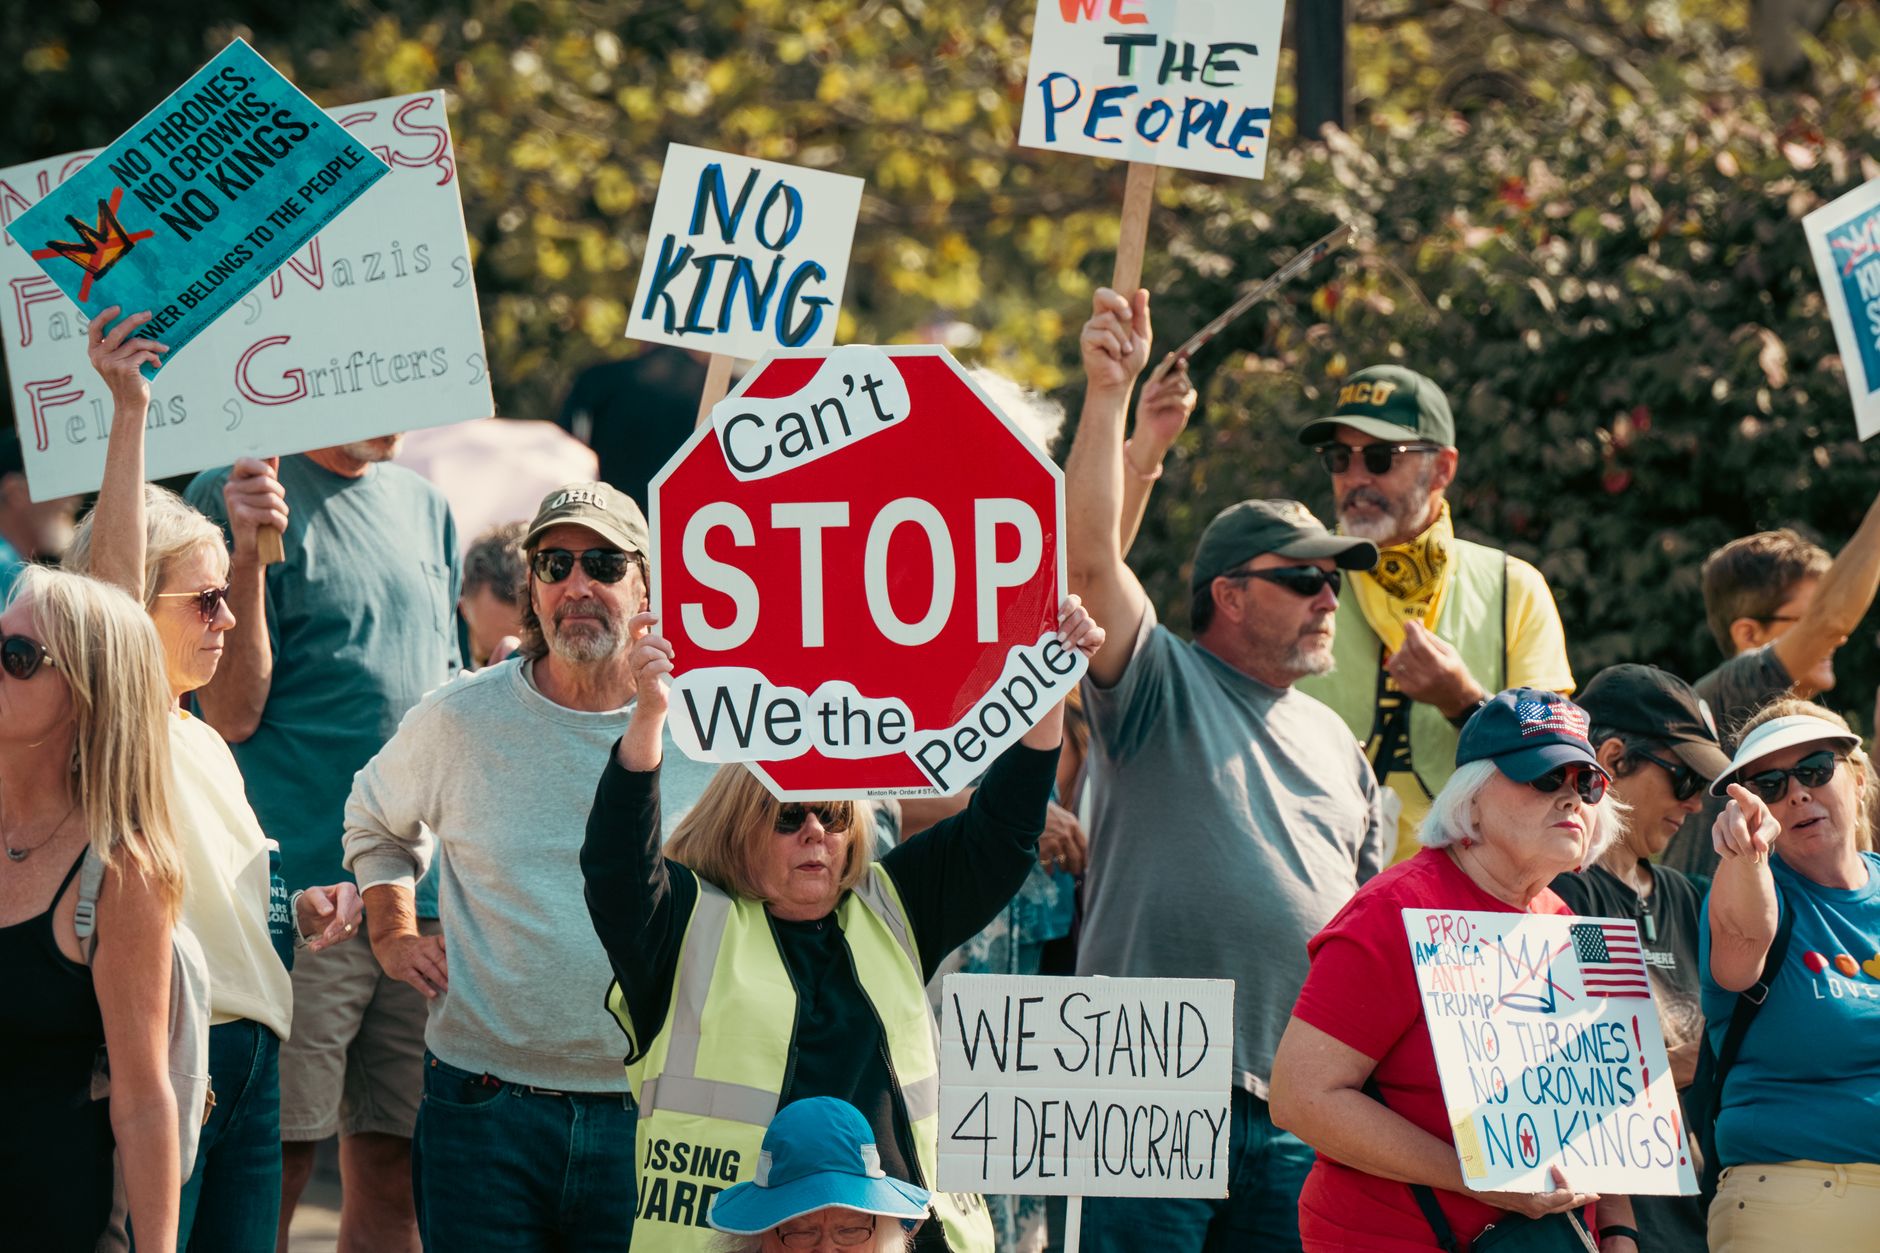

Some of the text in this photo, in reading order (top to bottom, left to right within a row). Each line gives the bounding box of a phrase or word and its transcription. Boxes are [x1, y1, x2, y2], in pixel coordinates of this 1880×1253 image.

[1103, 33, 1259, 87] THE
[108, 66, 255, 188] NO THRONES.
[132, 92, 277, 213] NO CROWNS.
[1037, 72, 1271, 158] PEOPLE
[159, 109, 319, 242] NO KINGS.
[688, 163, 803, 251] NO
[177, 244, 254, 309] BELONGS
[244, 225, 274, 249] TO
[266, 197, 306, 230] THE
[297, 145, 365, 204] PEOPLE
[641, 234, 834, 347] KING
[722, 373, 894, 474] Can't
[551, 489, 608, 511] OHIO
[680, 496, 1043, 651] STOP
[682, 638, 1077, 792] We the People
[1415, 941, 1486, 967] AMERICA
[1812, 977, 1879, 999] LOVE
[953, 992, 1209, 1078] WE STAND
[1426, 990, 1494, 1020] TRUMP
[1458, 1015, 1646, 1066] NO THRONES!
[1468, 1066, 1652, 1109] NO CROWNS!
[951, 1092, 1228, 1181] 4 DEMOCRACY
[1482, 1109, 1687, 1169] NO KINGS!
